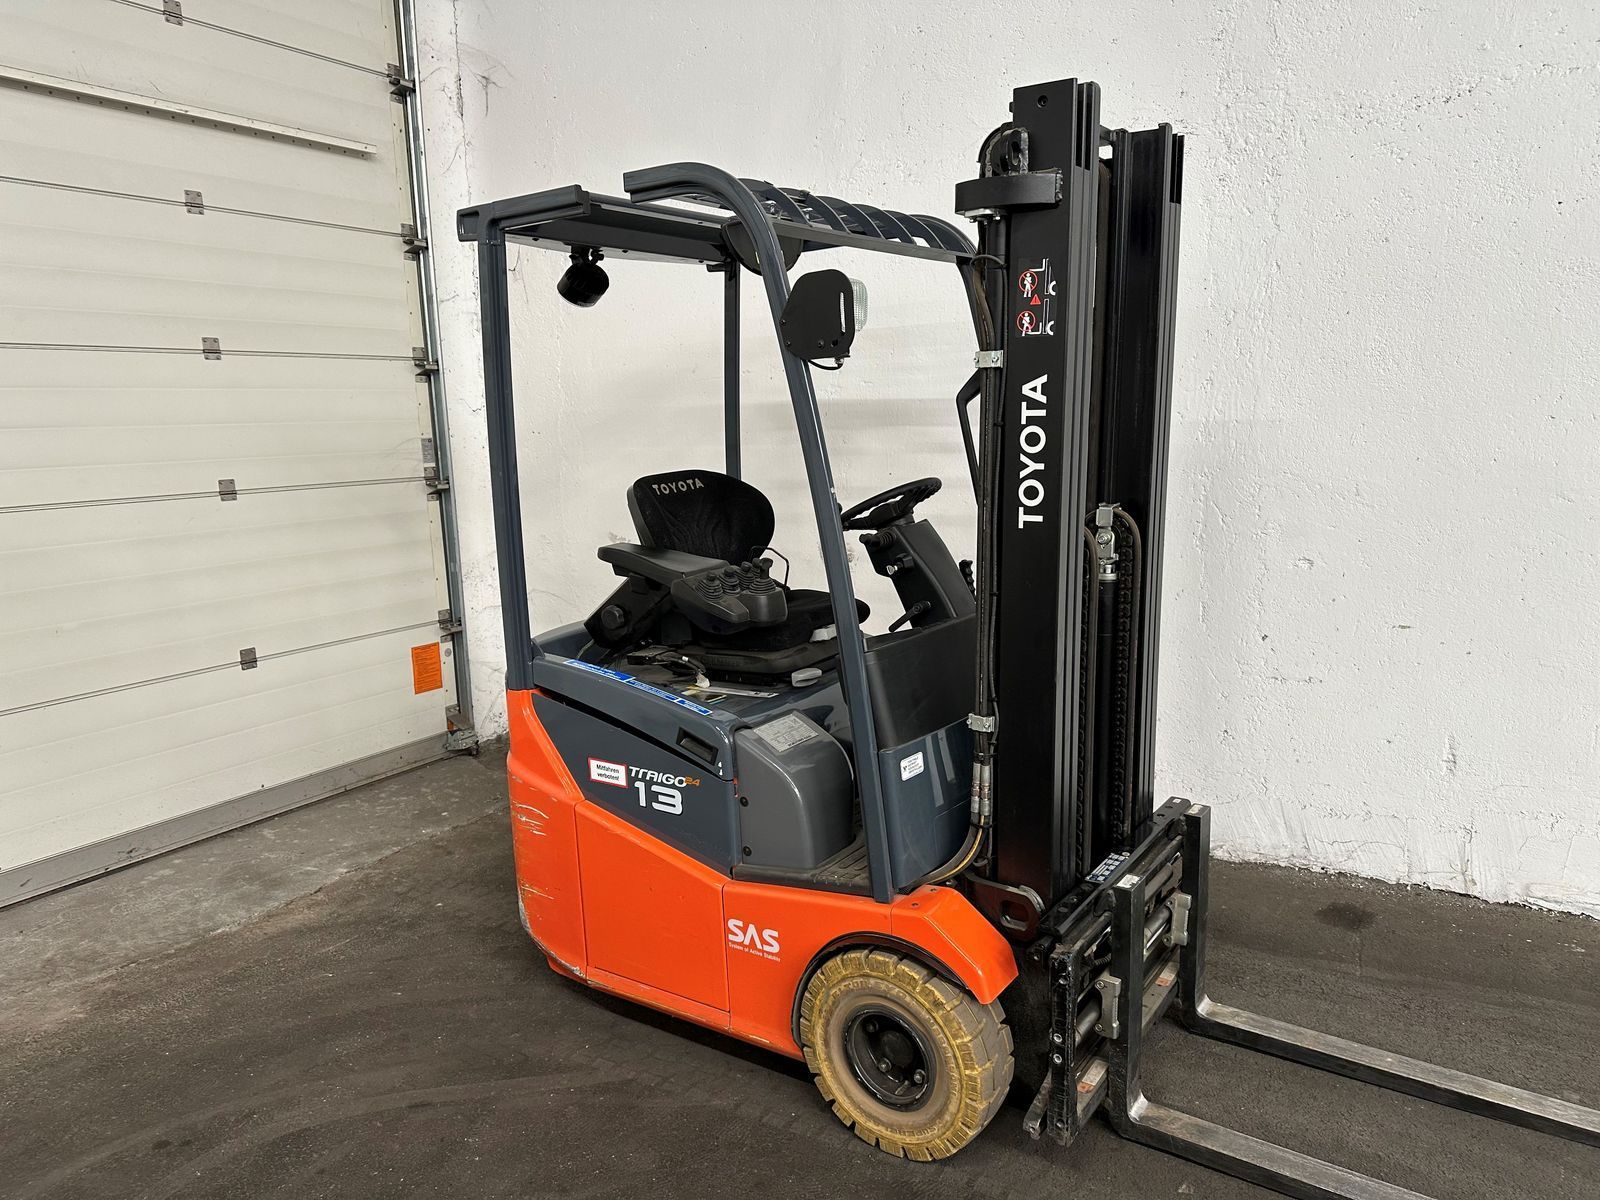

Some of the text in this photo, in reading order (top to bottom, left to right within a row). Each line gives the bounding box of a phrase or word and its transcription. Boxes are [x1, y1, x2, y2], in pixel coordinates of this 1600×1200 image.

[1018, 373, 1048, 529] TOYOTA
[651, 478, 705, 496] TOYOTA
[634, 781, 683, 815] 13
[727, 918, 780, 953] SAS
